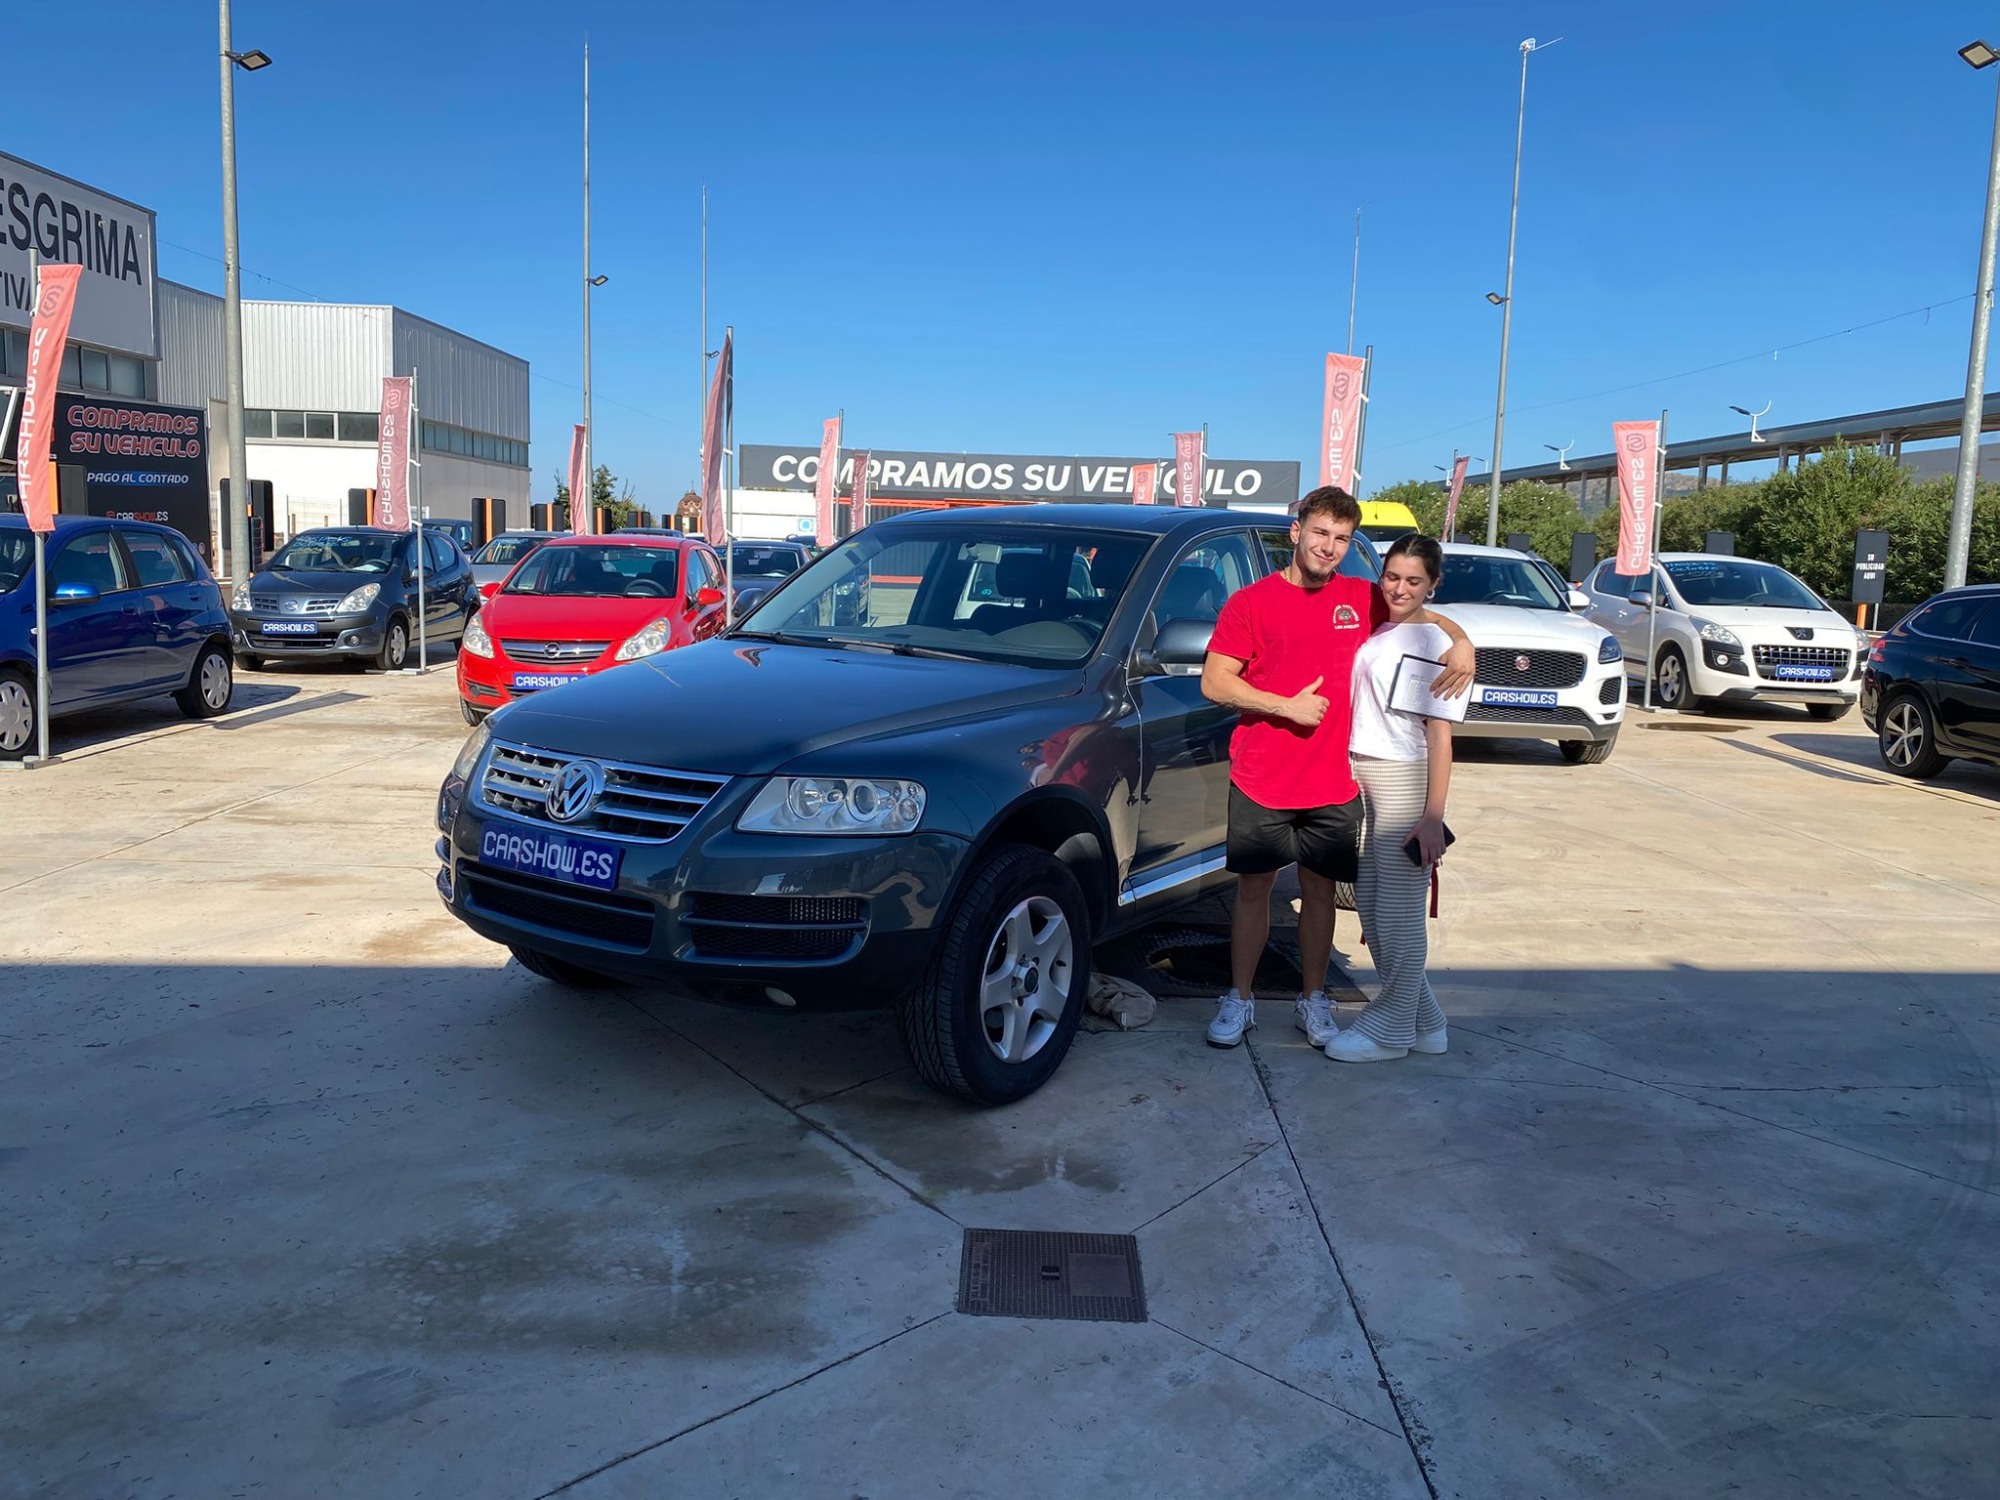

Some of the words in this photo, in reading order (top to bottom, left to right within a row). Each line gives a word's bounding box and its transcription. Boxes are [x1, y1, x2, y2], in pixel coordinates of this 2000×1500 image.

[67, 404, 199, 434] COMPRAMOS
[69, 431, 101, 453] SU
[103, 432, 201, 458] VEHICULO
[87, 472, 119, 483] PAGO
[121, 473, 136, 483] AL
[138, 473, 189, 484] CONTADO
[1022, 464, 1072, 493] SU
[262, 622, 315, 633] CARSHOW.ES
[1779, 667, 1832, 677] CARSHOW.ES
[1484, 691, 1556, 705] CARSHOW.ES
[483, 831, 613, 880] CARSHOW.ES
